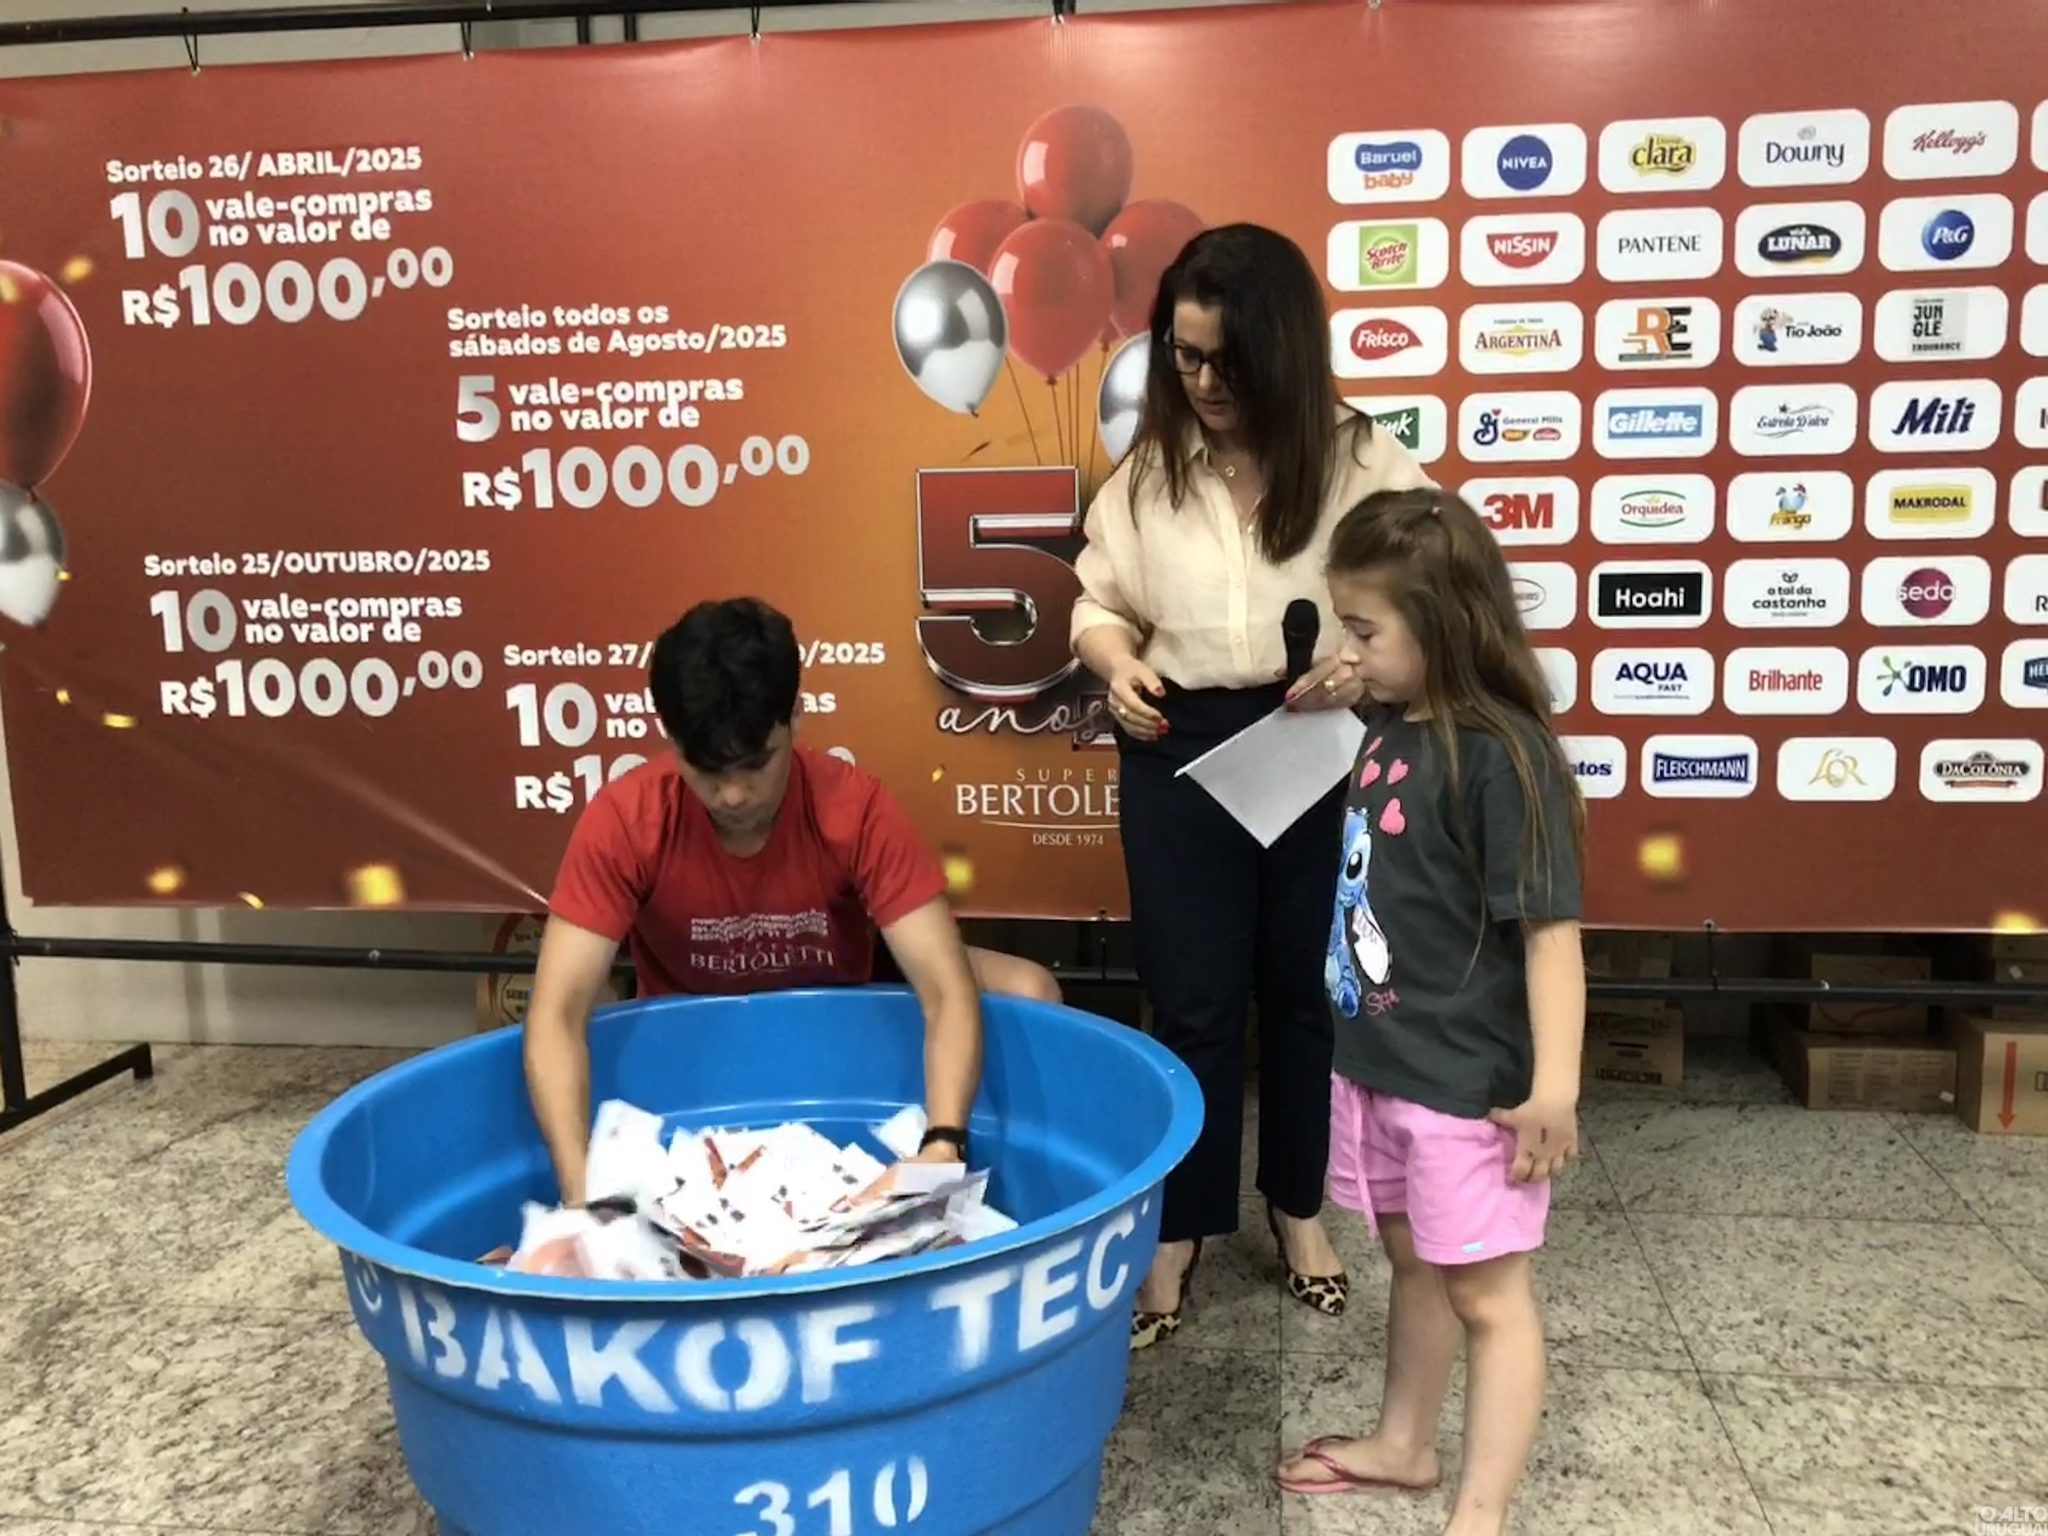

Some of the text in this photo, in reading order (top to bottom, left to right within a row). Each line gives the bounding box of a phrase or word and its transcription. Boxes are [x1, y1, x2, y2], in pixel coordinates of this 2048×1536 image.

[1632, 137, 1692, 166] clara
[1766, 141, 1845, 167] Downy
[1912, 129, 1987, 154] Kellogg's
[106, 146, 422, 183] Sorteio 26/ ABRIL/2025
[1360, 149, 1417, 165] Baruel
[1502, 156, 1547, 169] NIVEA
[1363, 172, 1413, 190] baby
[205, 188, 433, 220] vale-compras
[110, 189, 200, 259] 10
[209, 214, 391, 246] no valor de
[1932, 225, 1969, 244] P&G
[1494, 236, 1551, 256] NISSIN
[1618, 235, 1701, 254] PANTENE
[1767, 234, 1832, 252] LUNAR
[121, 246, 454, 328] R$1000,00
[447, 303, 669, 330] Sorteio todos os
[449, 323, 787, 358] sábados de Agosto/2025
[1475, 329, 1562, 349] ARGENTINA
[1785, 323, 1842, 338] Tio João
[508, 376, 744, 406] vale-compras
[456, 375, 500, 443] 5
[511, 399, 700, 432] no valor de
[1609, 409, 1698, 434] Gillette
[1891, 397, 1976, 435] Mili
[462, 434, 810, 511] R$1000,00
[1483, 493, 1554, 530] 3M
[1893, 496, 1967, 509] MAKRODAL
[144, 548, 491, 578] Sorteio 25/OUTUBRO/2025
[1615, 587, 1685, 609] Hoahi
[1752, 597, 1826, 609] castanha
[1778, 586, 1795, 596] tal
[1796, 585, 1813, 596] da
[241, 593, 462, 620] vale-compras
[150, 588, 237, 653] 10
[245, 616, 421, 643] no valor de
[503, 641, 602, 667] Sorteio
[160, 650, 483, 718] R$1000,00
[1615, 662, 1688, 684] AQUA
[1749, 669, 1823, 692] Brilhante
[1907, 664, 1967, 693] OMO
[506, 682, 598, 747] 10
[606, 717, 648, 738] no
[938, 700, 1102, 741] anos
[1016, 768, 1118, 782] SUPER
[1655, 757, 1747, 778] FLEISCHMANN
[956, 784, 1121, 816] BERTOLE
[1032, 833, 1104, 846] DESDE 1974
[399, 1207, 1135, 1413] BAKOF TEC
[733, 1455, 929, 1536] 310
